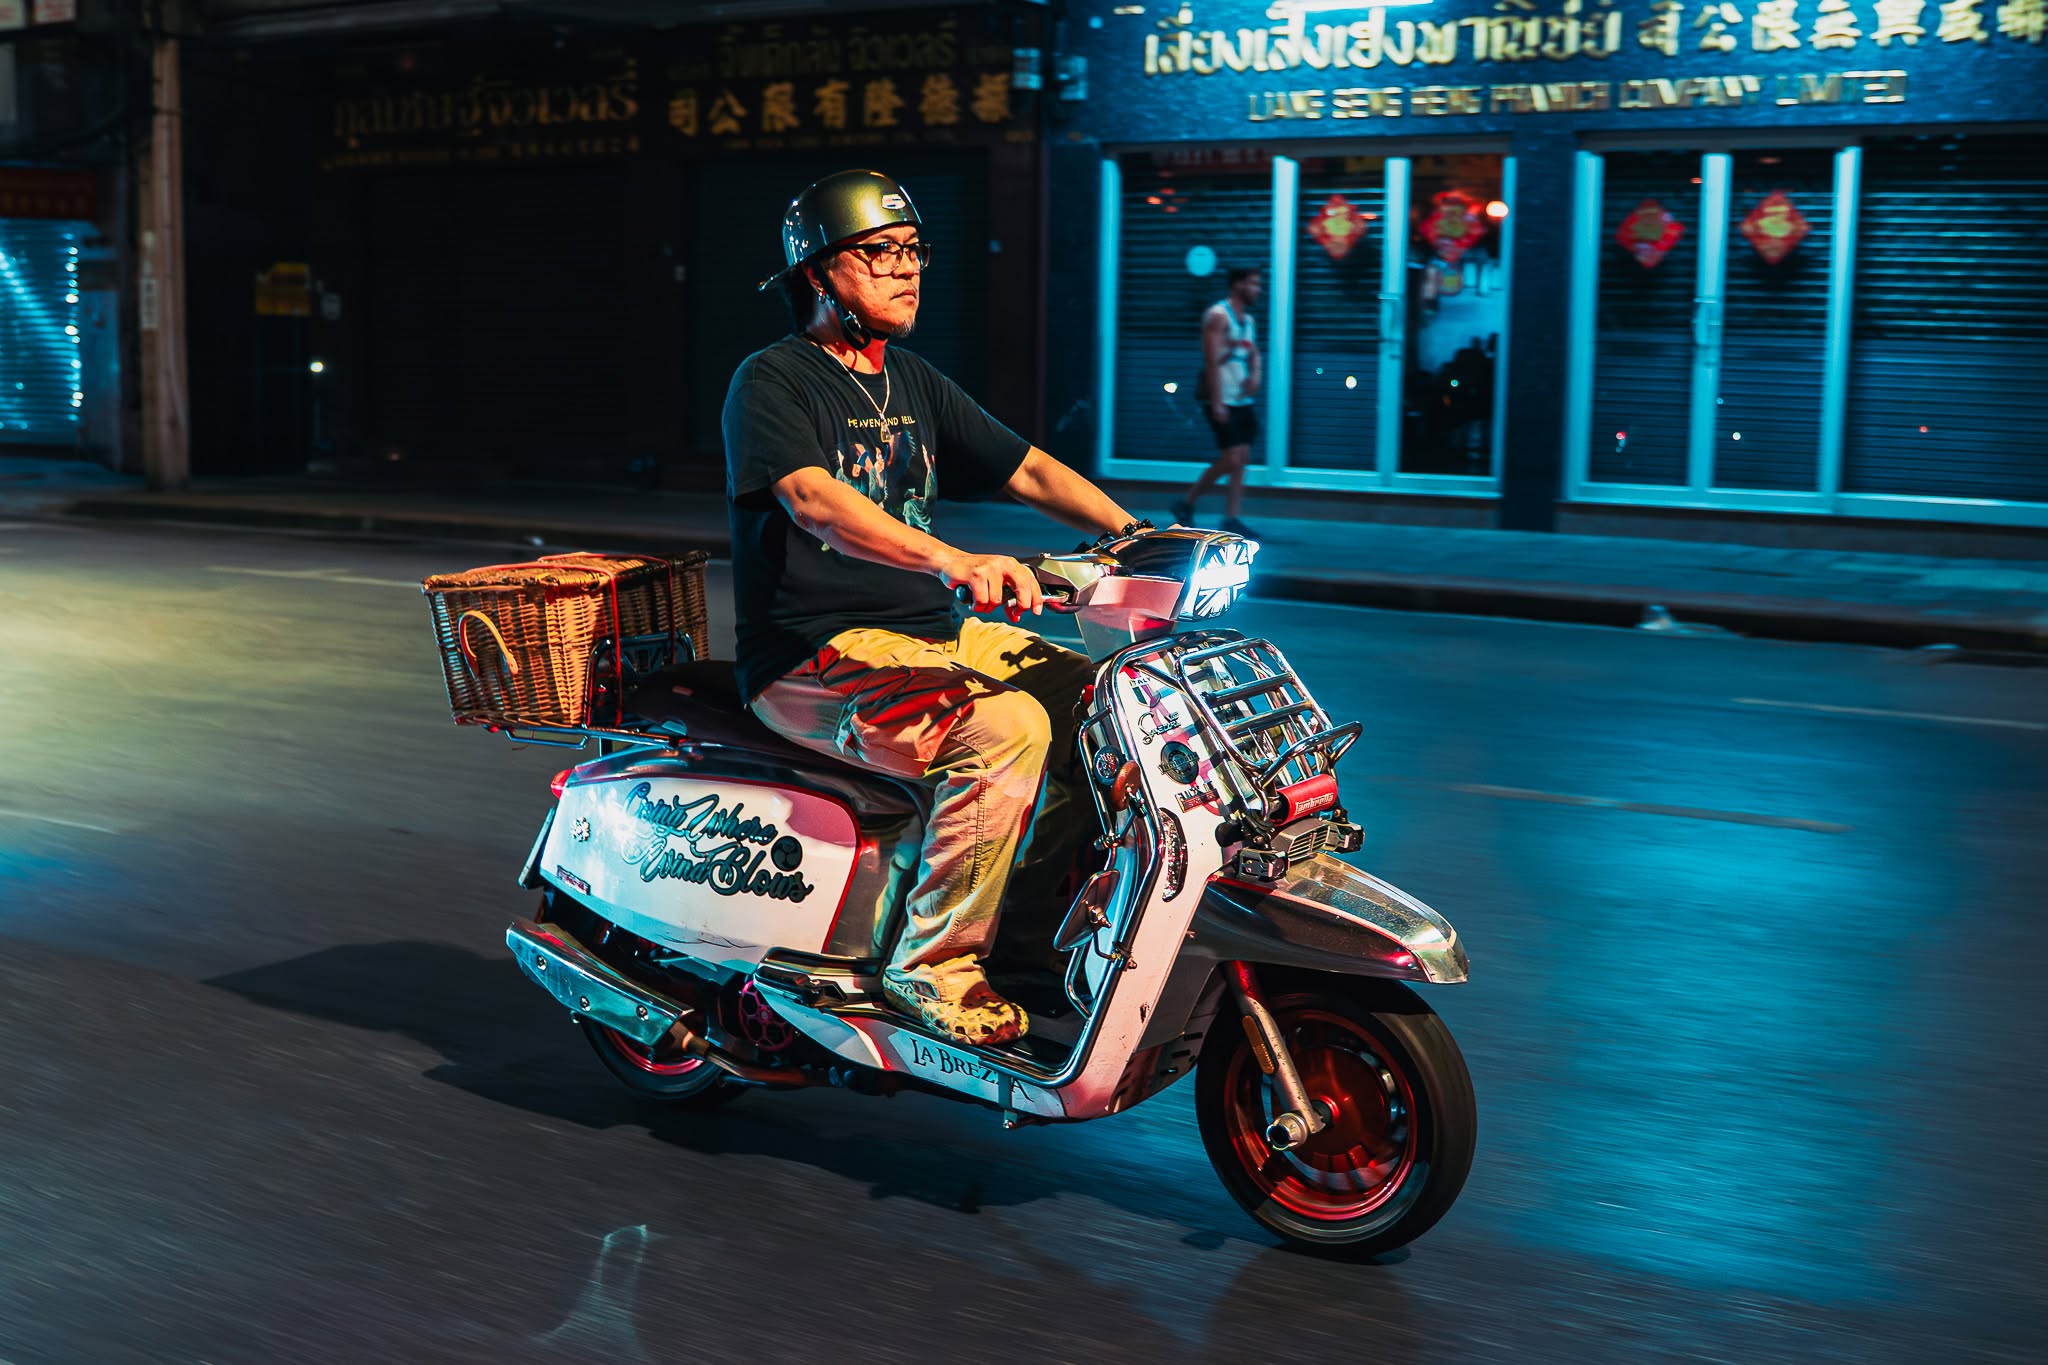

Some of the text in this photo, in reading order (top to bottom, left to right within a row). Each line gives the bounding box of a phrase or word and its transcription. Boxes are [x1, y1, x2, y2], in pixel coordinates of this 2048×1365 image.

[1332, 86, 1403, 119] SENG
[1776, 69, 1909, 106] LIMITED
[847, 417, 881, 428] HEAVEN
[1129, 676, 1151, 687] ITALY
[691, 840, 815, 904] Blows
[909, 1036, 1035, 1104] LA BREZA
